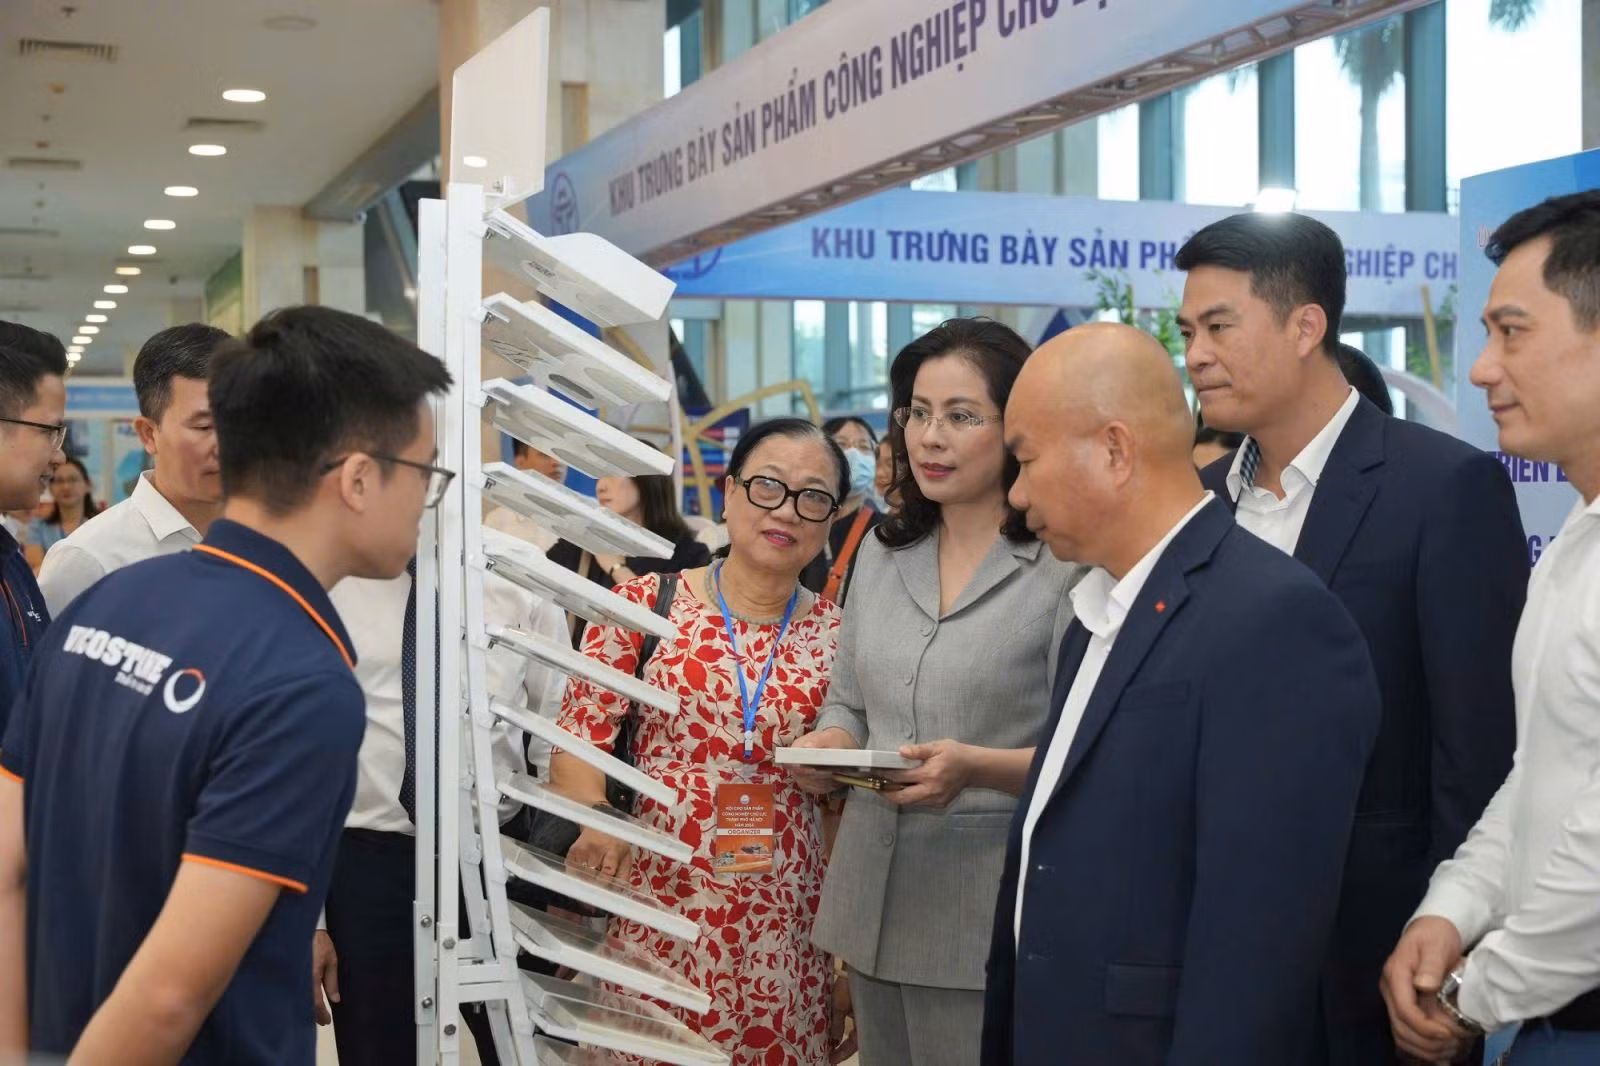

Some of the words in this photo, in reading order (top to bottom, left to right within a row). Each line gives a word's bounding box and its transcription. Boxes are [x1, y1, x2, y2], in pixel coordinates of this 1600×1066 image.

[608, 170, 634, 217] KHU
[637, 147, 683, 203] TRƯNG
[687, 127, 717, 182] BÀY
[721, 101, 755, 166] SẢN
[762, 67, 816, 149] PHẨM
[824, 46, 882, 120] CÔNG
[811, 227, 875, 259] KHU
[887, 228, 989, 264] TRƯNG
[1000, 227, 1058, 265] BÀY
[1069, 227, 1129, 268] SẢN
[1343, 242, 1415, 285] GHIỆP
[1424, 252, 1457, 279] CH
